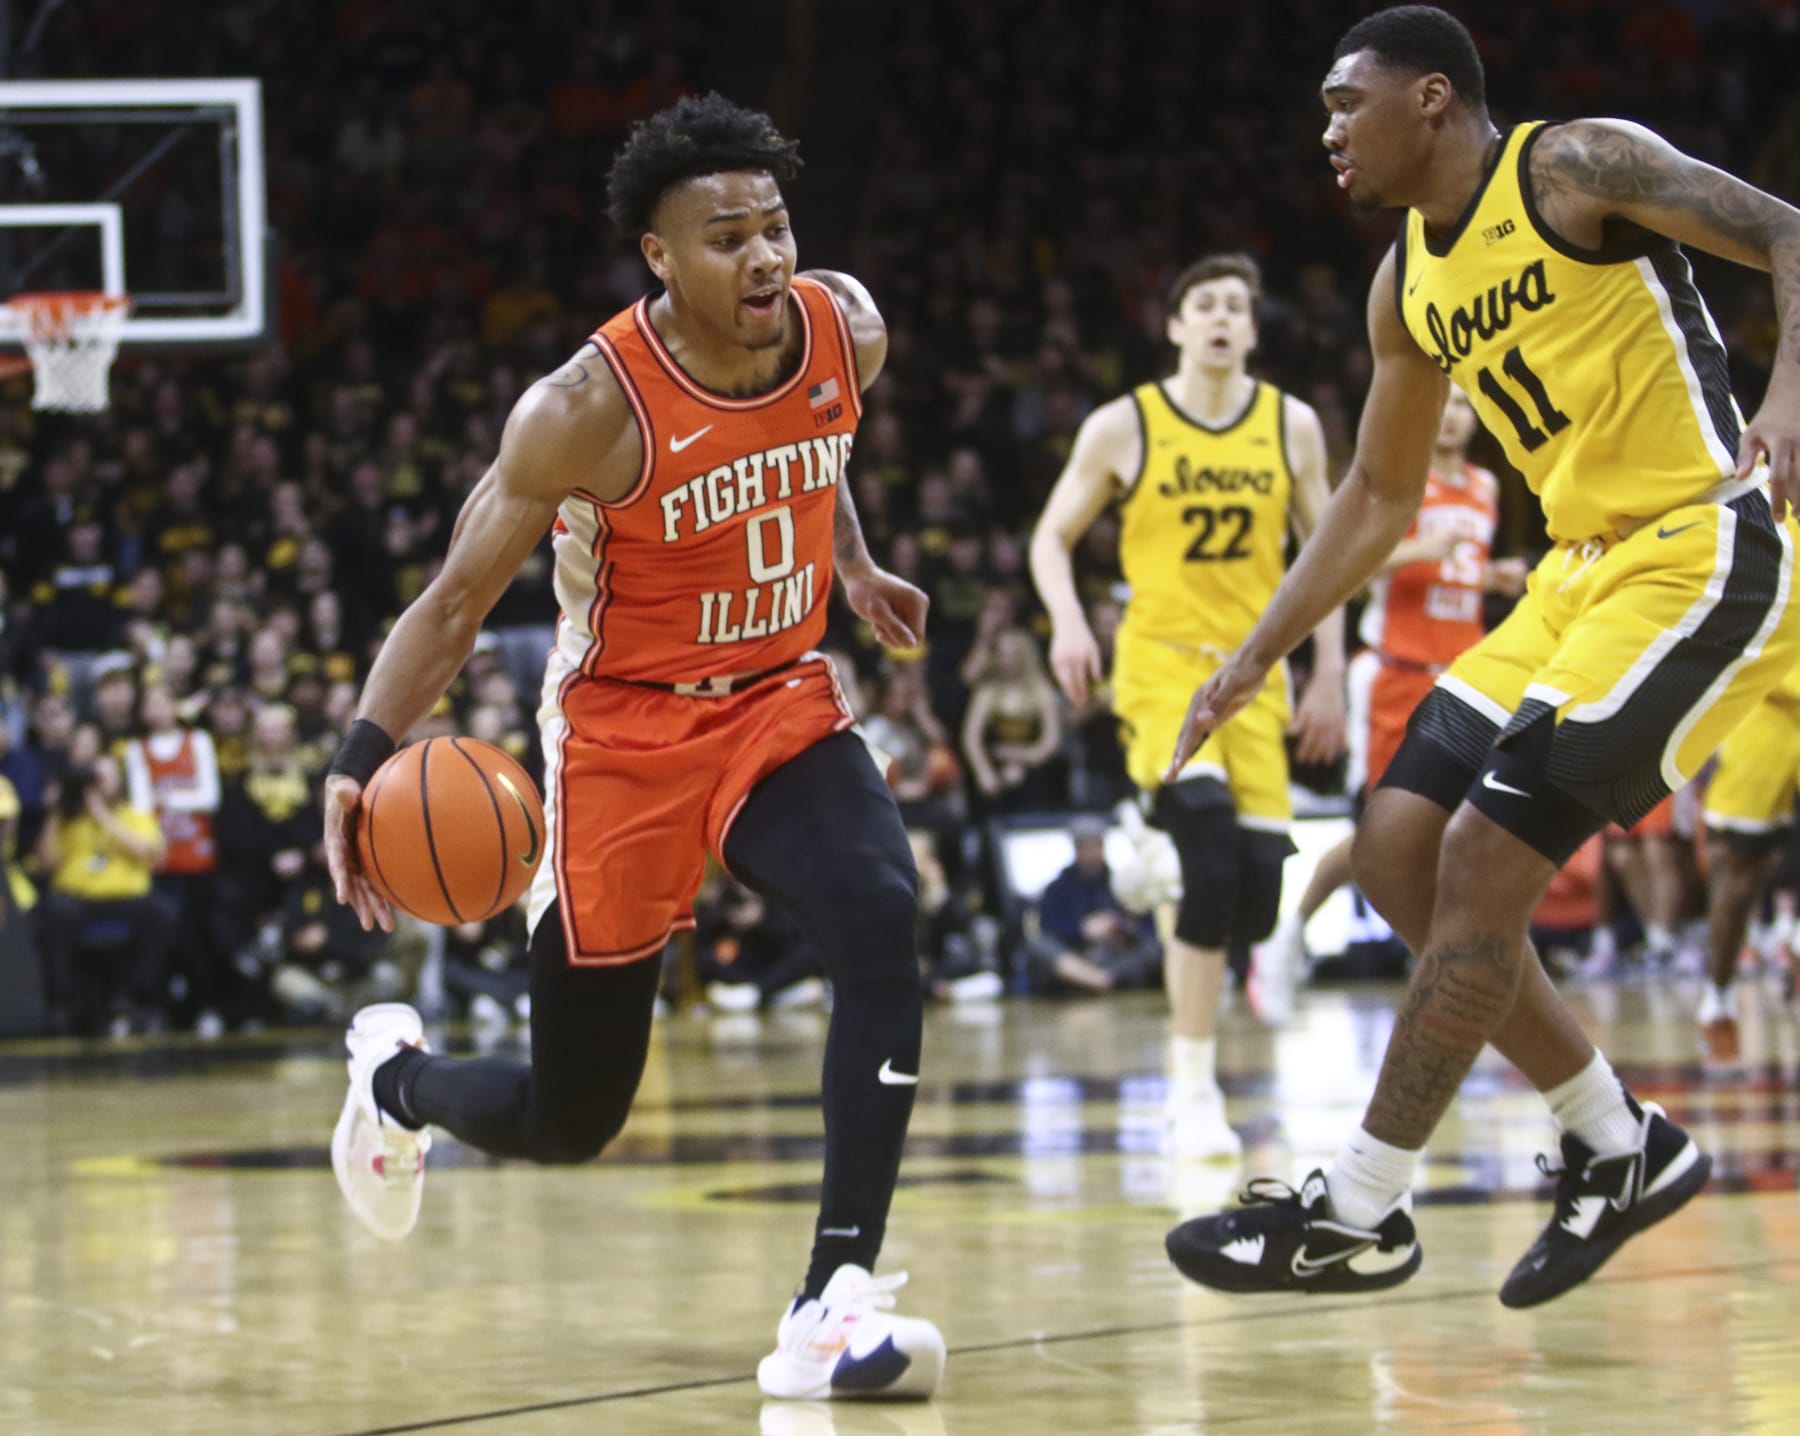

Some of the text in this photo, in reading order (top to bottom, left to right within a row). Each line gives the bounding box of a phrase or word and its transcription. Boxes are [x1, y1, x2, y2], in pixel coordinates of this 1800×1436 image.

[1426, 259, 1555, 374] Iowa
[1478, 345, 1572, 453] 11
[660, 432, 852, 543] FIGHTING
[1158, 454, 1275, 498] Iowa
[746, 504, 795, 584] 0
[1181, 506, 1254, 562] 22
[697, 563, 814, 644] ILLINI
